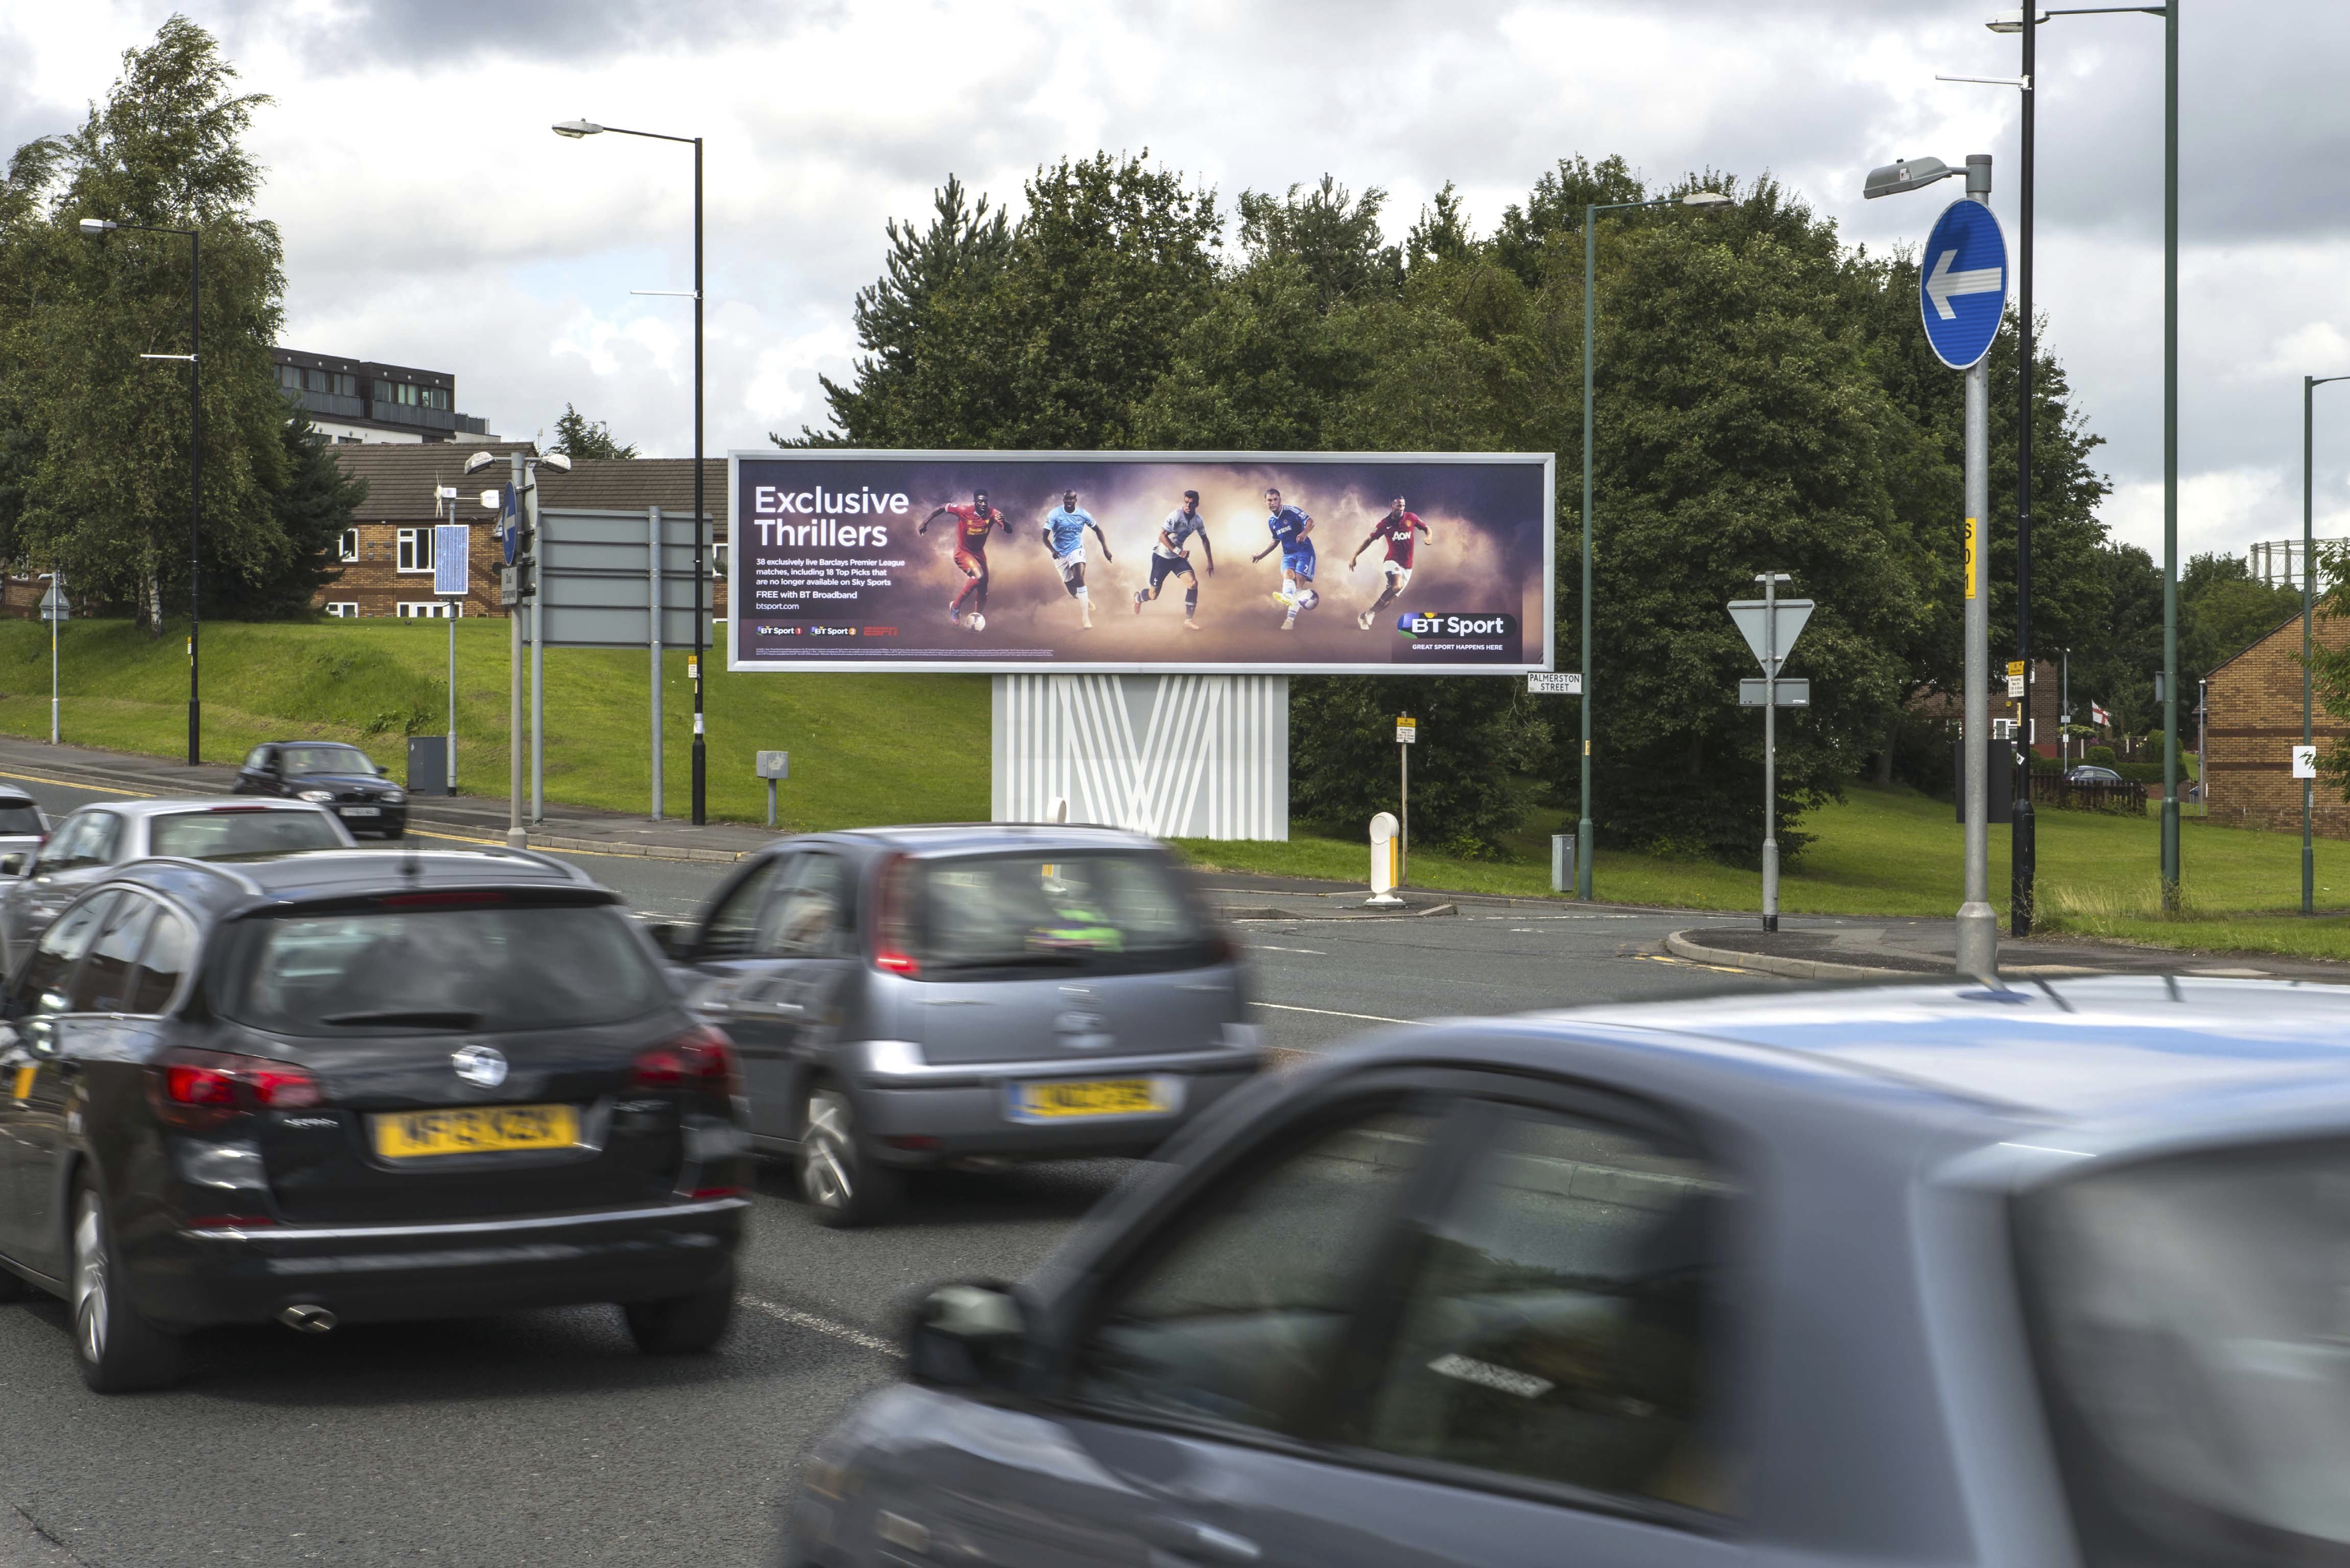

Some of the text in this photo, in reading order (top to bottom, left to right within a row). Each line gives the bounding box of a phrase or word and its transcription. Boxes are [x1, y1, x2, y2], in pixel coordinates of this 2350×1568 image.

[756, 486, 909, 514] Exclusive
[754, 518, 888, 547] Thrillers
[1392, 531, 1411, 541] AON
[767, 558, 804, 566] exclusively
[852, 579, 865, 587] Sky
[867, 579, 891, 587] Sports
[1412, 616, 1503, 636] BT Sport
[774, 627, 794, 635] Sport
[863, 627, 898, 636] ESPN
[1530, 674, 1580, 682] PALMERSTON
[1541, 683, 1569, 691] STREET
